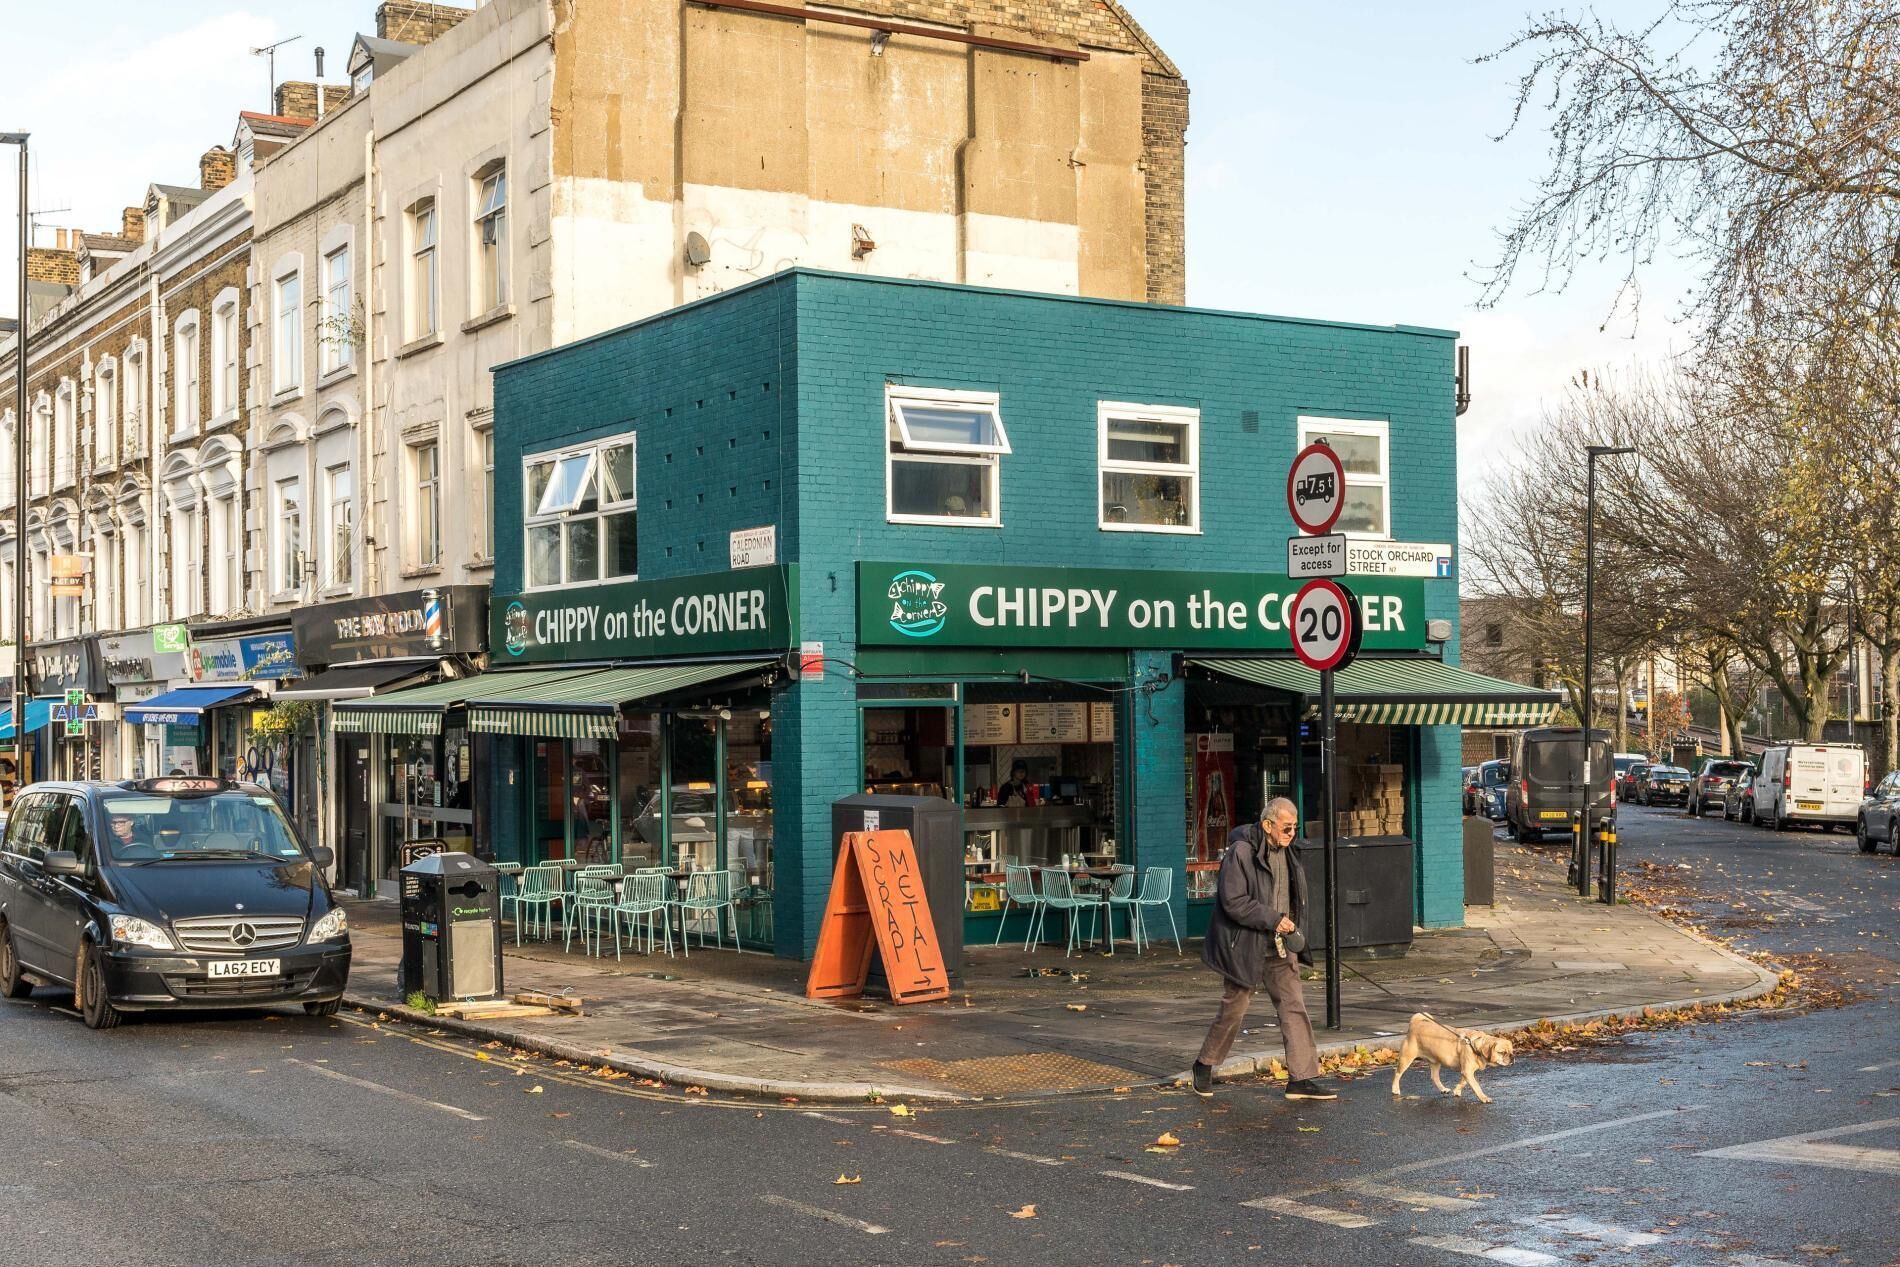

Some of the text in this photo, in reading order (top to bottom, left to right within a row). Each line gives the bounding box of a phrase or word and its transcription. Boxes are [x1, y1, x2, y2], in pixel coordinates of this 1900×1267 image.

[732, 535, 773, 552] CALEDONIAN
[1292, 541, 1342, 557] Except for
[732, 552, 750, 566] ROAD
[1349, 549, 1434, 562] STOCK ORCHARD
[1300, 558, 1333, 571] access
[1349, 561, 1387, 573] STREET
[535, 605, 600, 645] CHIPPY
[603, 610, 628, 641] on
[633, 598, 666, 638] the
[671, 589, 767, 636] CORNER
[968, 586, 1406, 632] CHIPPY on the CER
[334, 617, 362, 639] THE
[1299, 605, 1342, 643] 20
[170, 780, 207, 789] TAXI
[866, 838, 936, 972] SCRAP METAL
[213, 960, 276, 975] LA62 ECY
